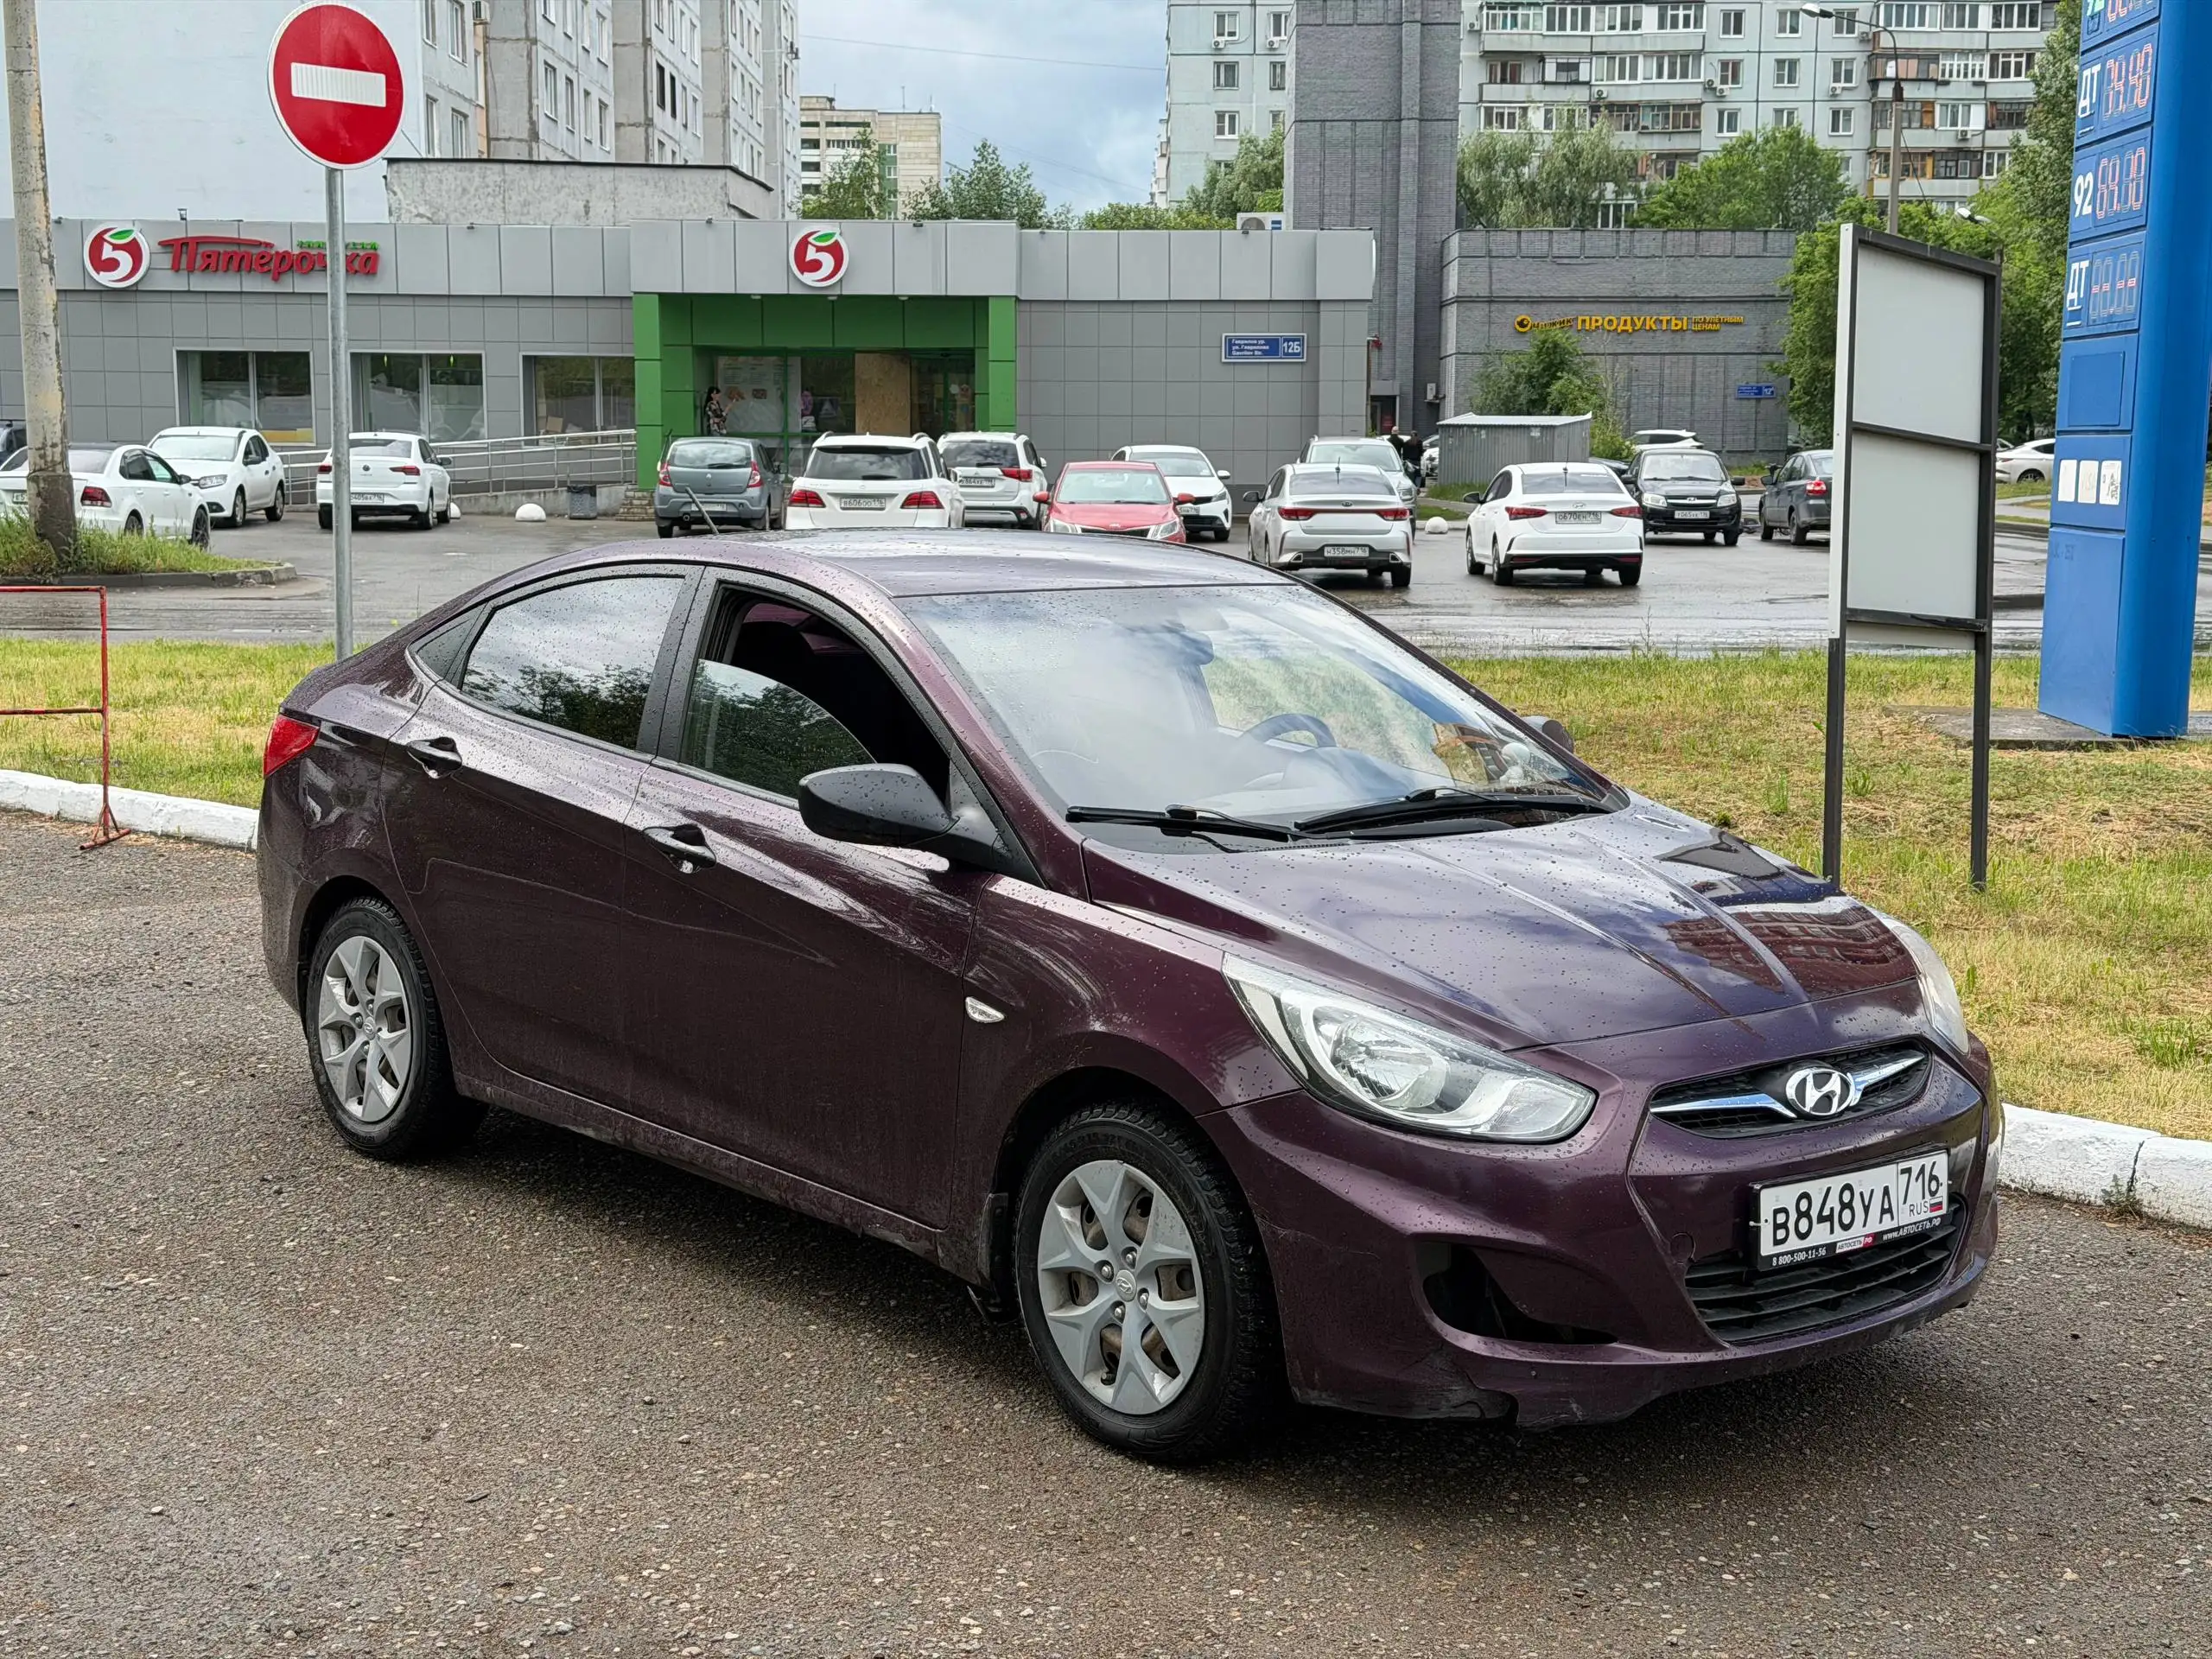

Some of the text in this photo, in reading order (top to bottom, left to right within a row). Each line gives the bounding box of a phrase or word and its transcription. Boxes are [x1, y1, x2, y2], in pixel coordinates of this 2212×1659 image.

[2074, 171, 2094, 218] 92
[1577, 315, 1688, 334] ПРОДУКТЫ
[1282, 341, 1301, 353] 12Б
[1772, 1160, 1941, 1247] В848УА 716
[1908, 1200, 1929, 1217] RUS
[1778, 1247, 1827, 1266] 800-500-11-56
